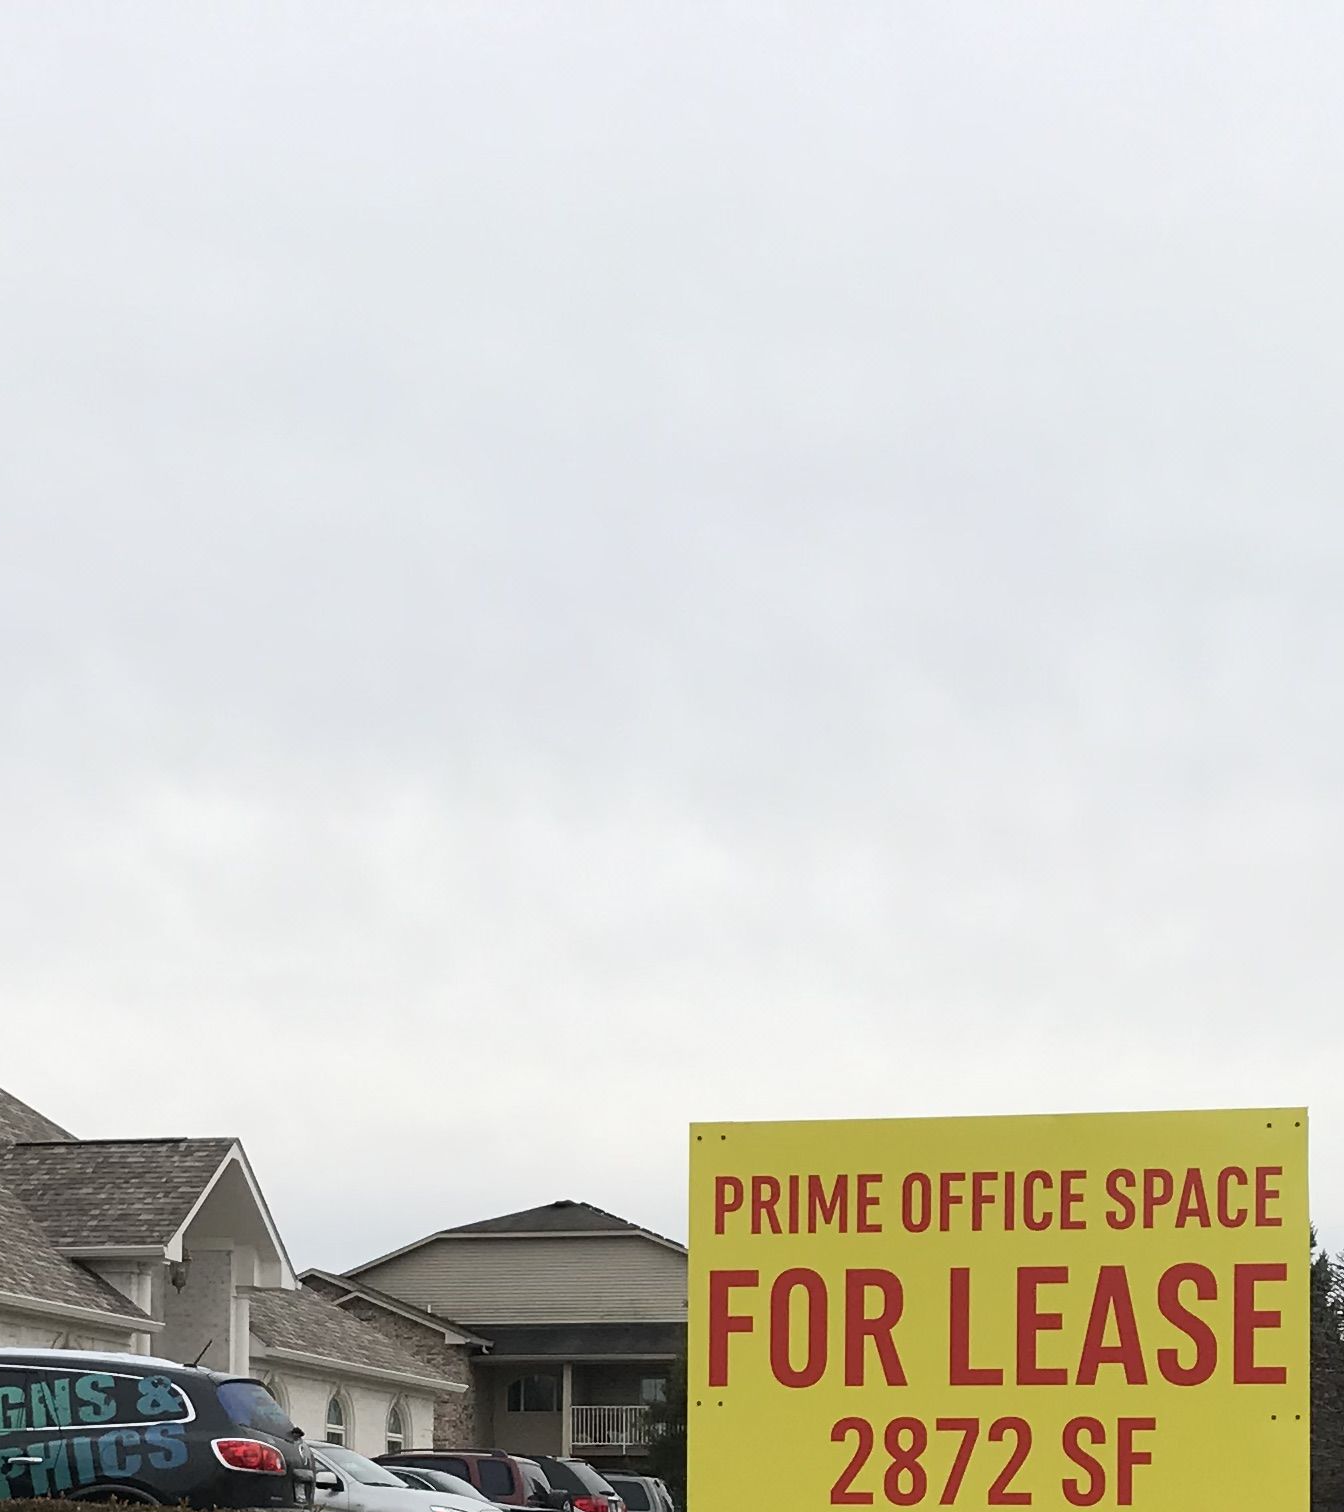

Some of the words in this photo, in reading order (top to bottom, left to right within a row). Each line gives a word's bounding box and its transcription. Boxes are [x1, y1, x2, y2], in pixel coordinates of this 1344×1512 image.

[714, 1173, 883, 1235] PRIME
[901, 1170, 1087, 1232] OFFICE
[1105, 1166, 1283, 1230] SPACE
[708, 1267, 908, 1389] FOR
[949, 1262, 1287, 1387] LEASE
[136, 1375, 183, 1416] &
[829, 1416, 1033, 1506] 2872
[1061, 1416, 1156, 1507] SF
